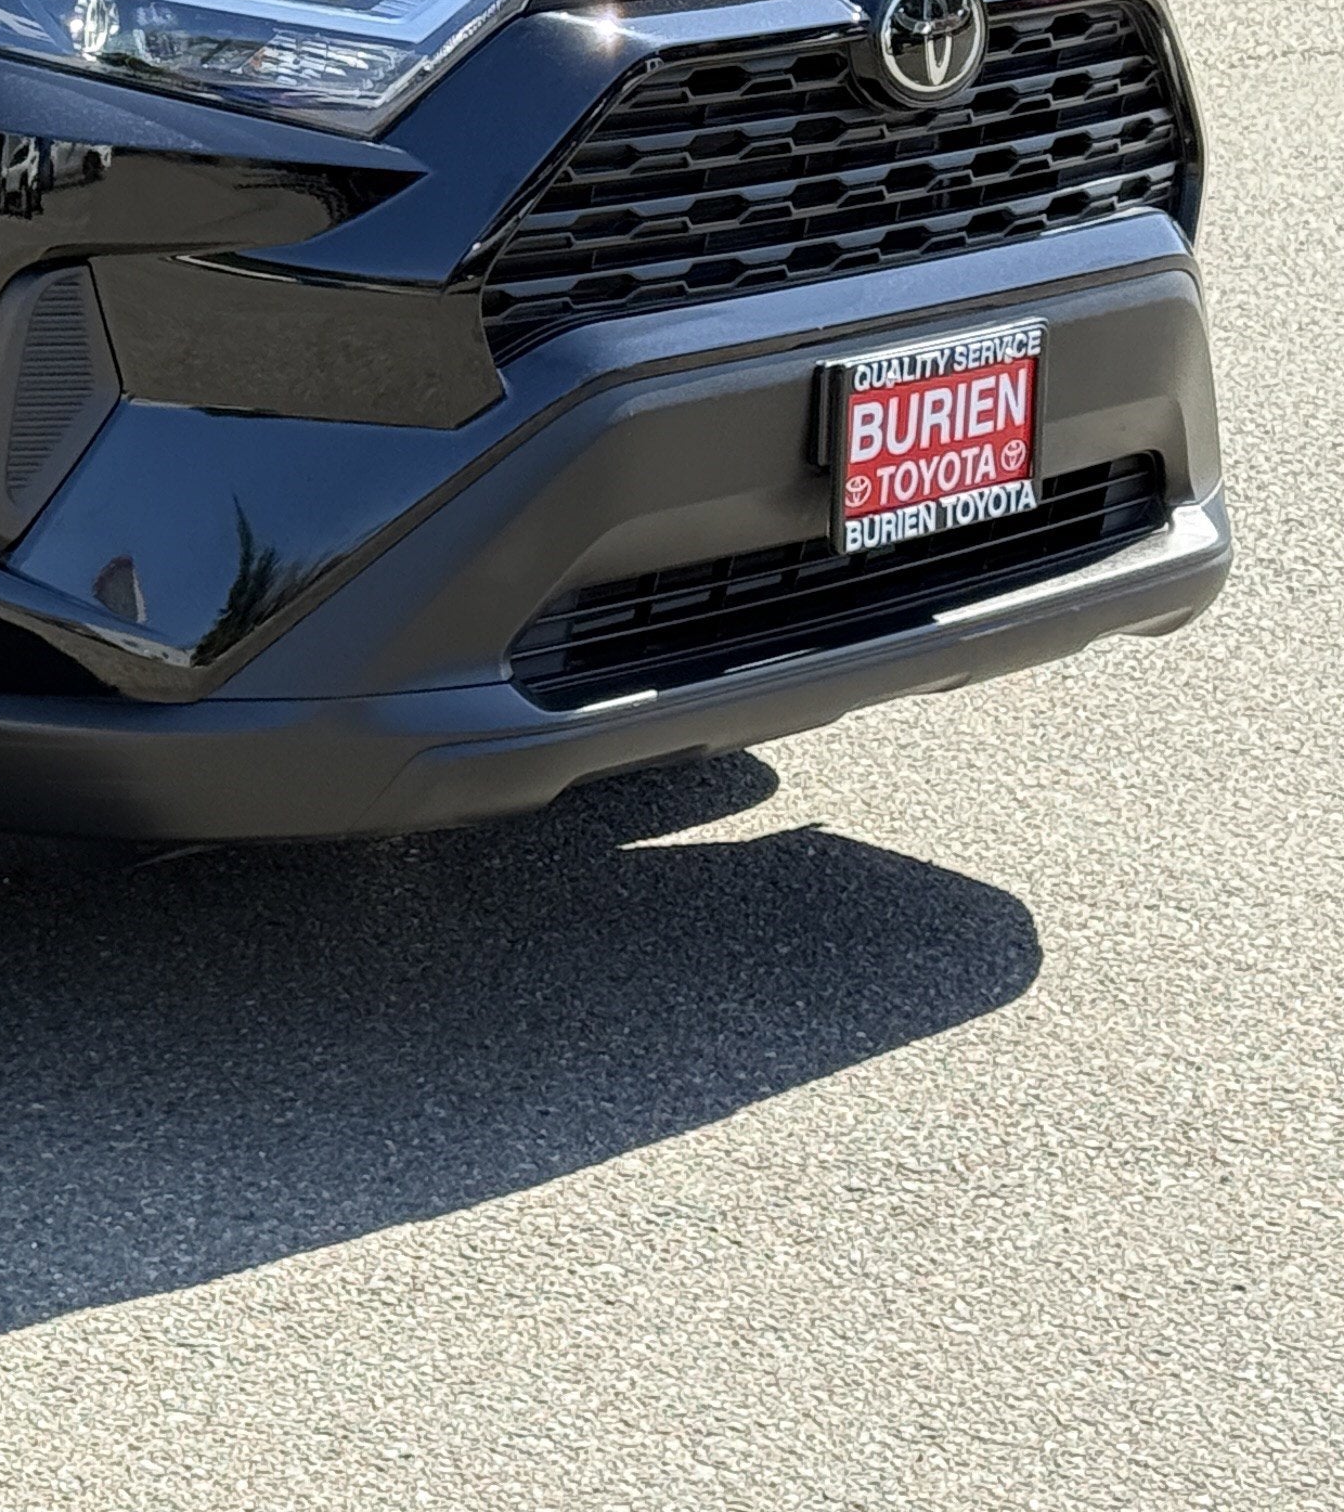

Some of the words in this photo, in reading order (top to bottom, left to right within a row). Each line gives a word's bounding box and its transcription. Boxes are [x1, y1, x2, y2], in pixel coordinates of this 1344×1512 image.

[854, 348, 953, 391] QUALITY
[953, 330, 1042, 372] SERVICE
[850, 368, 1028, 464] BURIEN
[876, 444, 997, 505] TOYOTA
[845, 500, 936, 552] BURIEN
[941, 480, 1037, 528] TOYOTA
